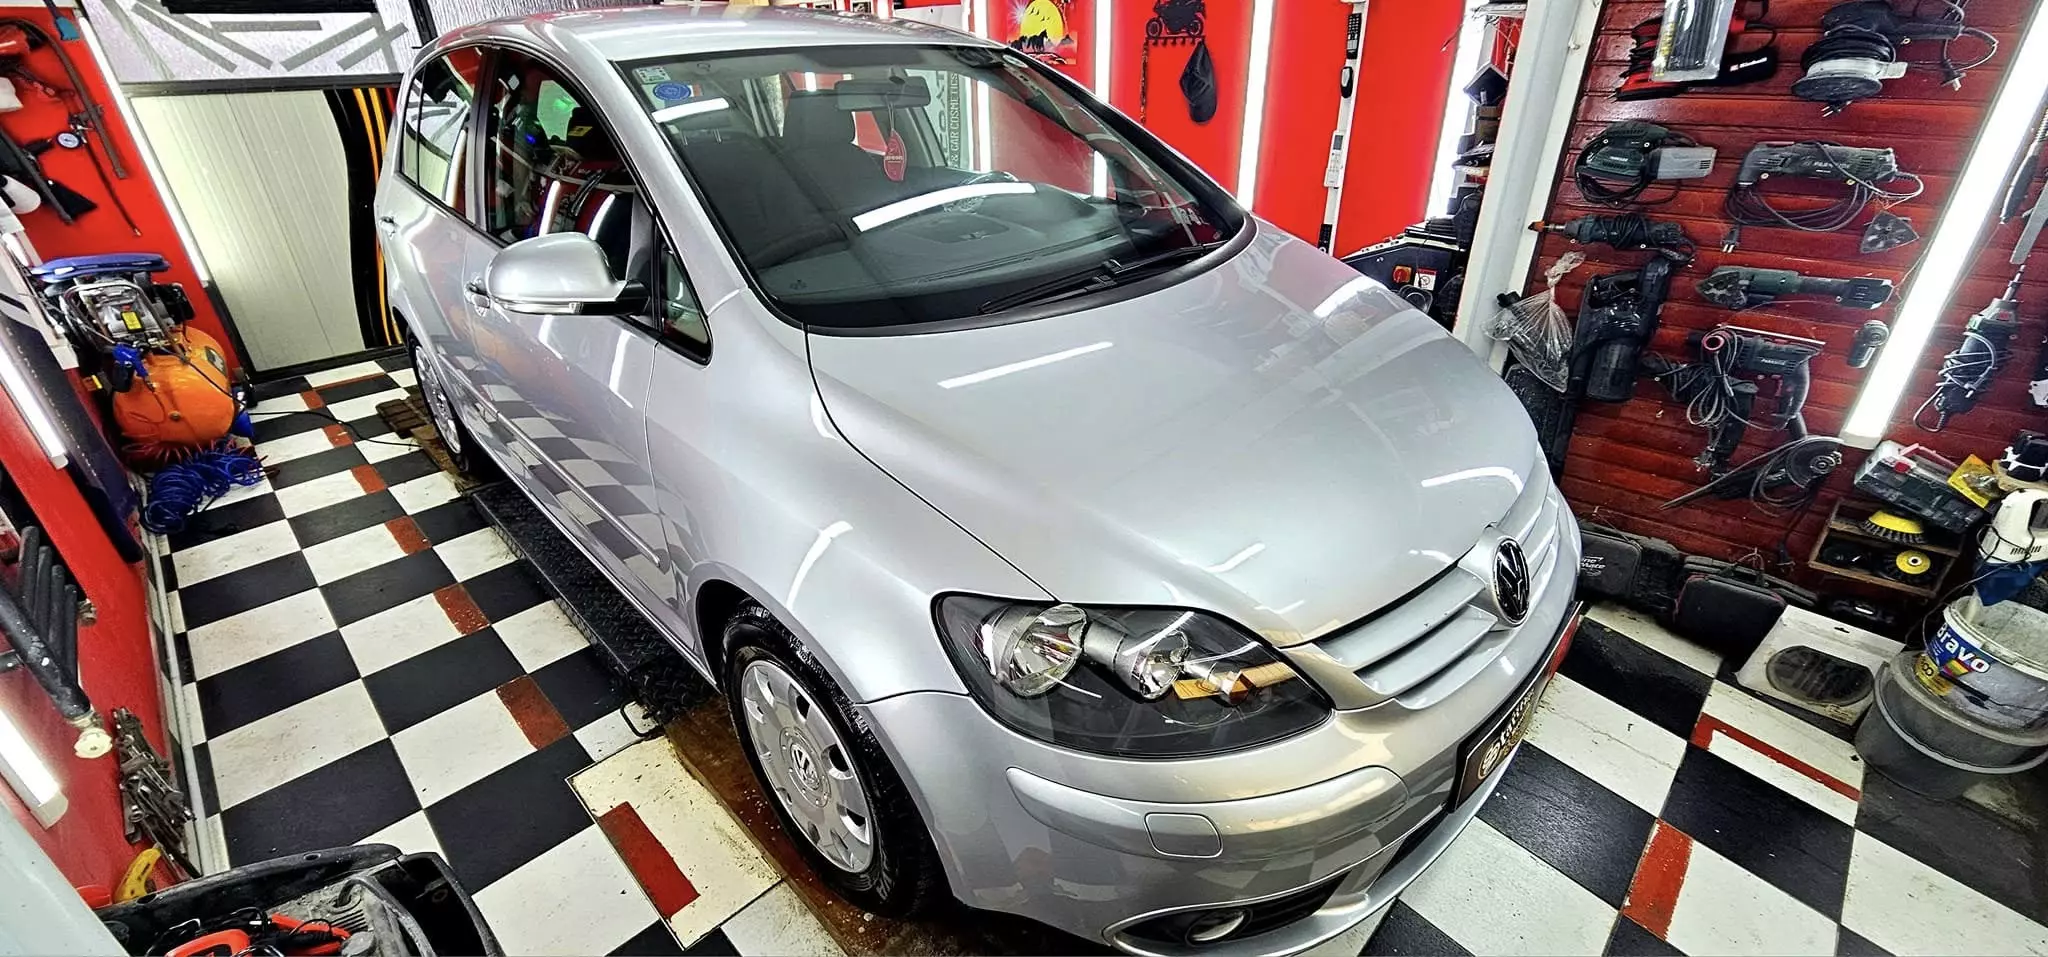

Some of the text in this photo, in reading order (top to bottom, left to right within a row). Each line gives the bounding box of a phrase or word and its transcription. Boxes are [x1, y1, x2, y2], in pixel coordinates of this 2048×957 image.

[950, 73, 959, 130] COSMETICS
[950, 132, 959, 151] CAR
[1936, 622, 1991, 674] Bravo
